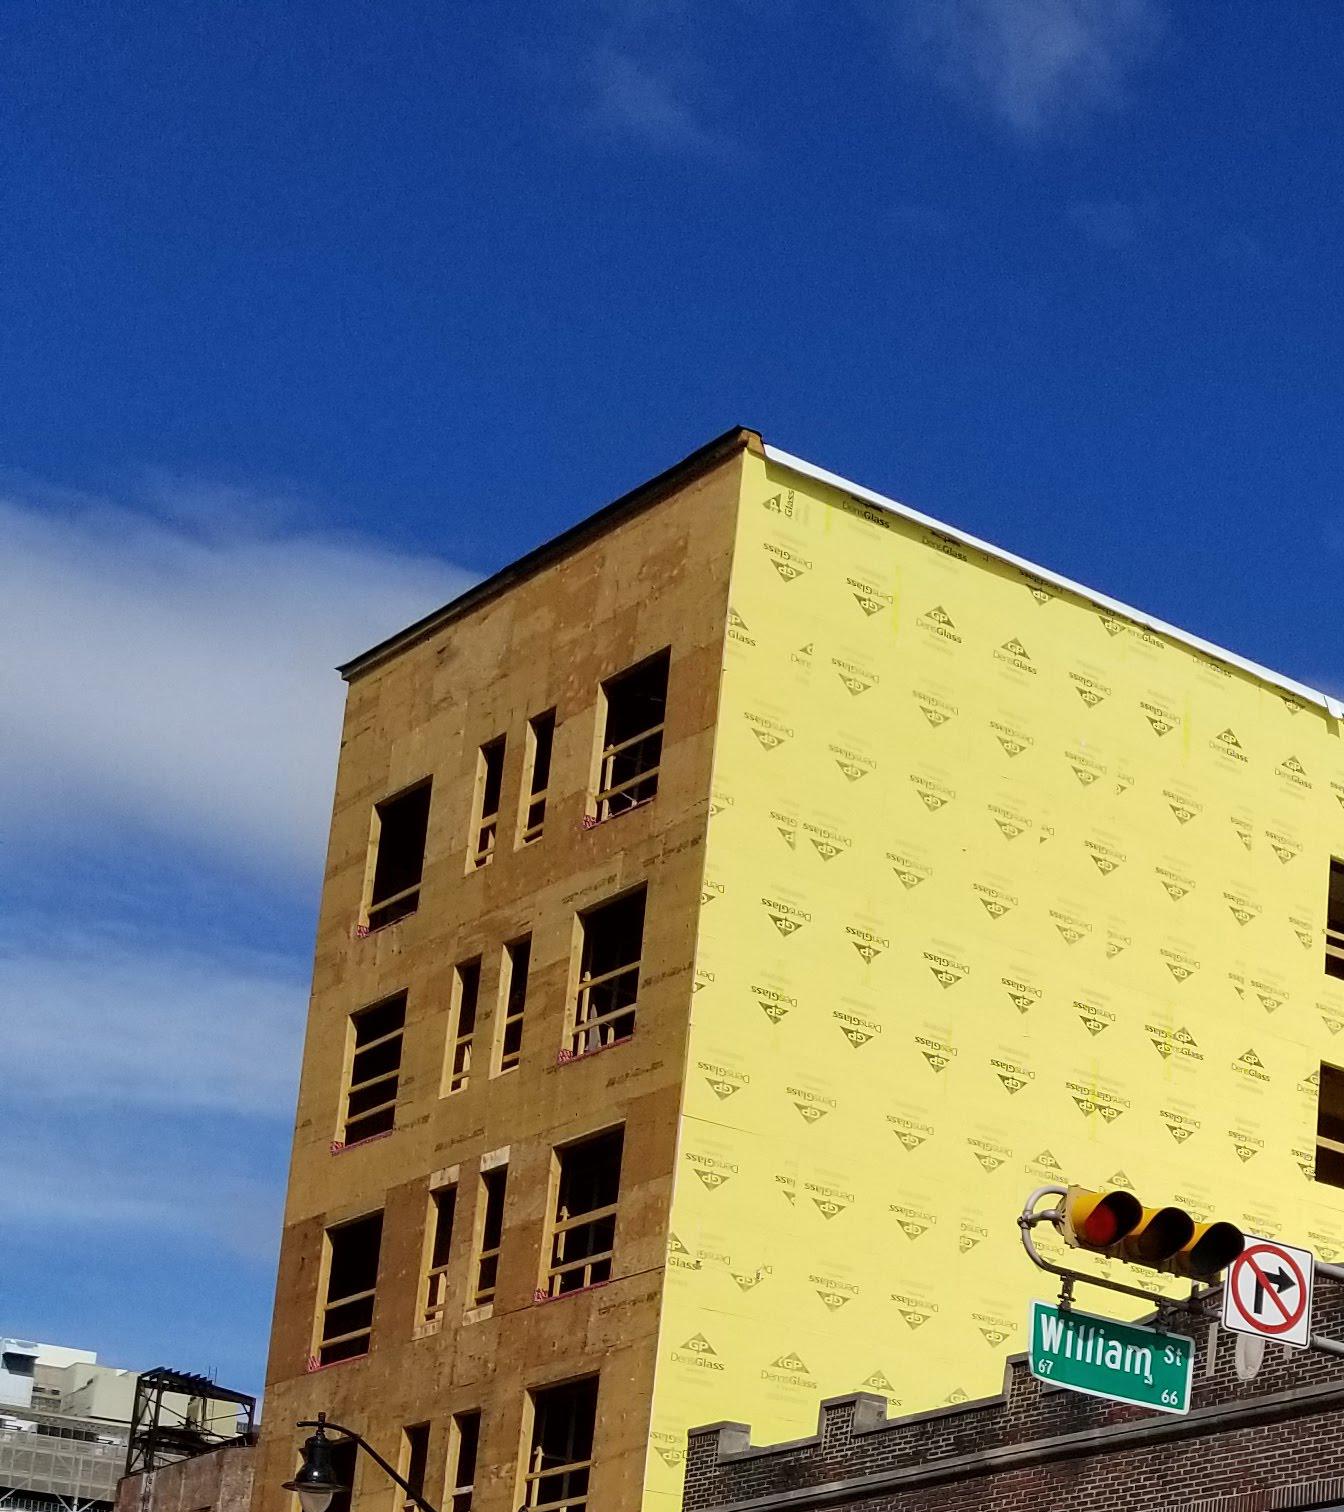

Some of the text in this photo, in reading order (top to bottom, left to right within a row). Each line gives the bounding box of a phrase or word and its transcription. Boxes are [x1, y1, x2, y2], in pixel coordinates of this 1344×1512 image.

[1041, 1314, 1182, 1375] William St
[1038, 1358, 1054, 1375] 67
[1161, 1390, 1178, 1405] 66
